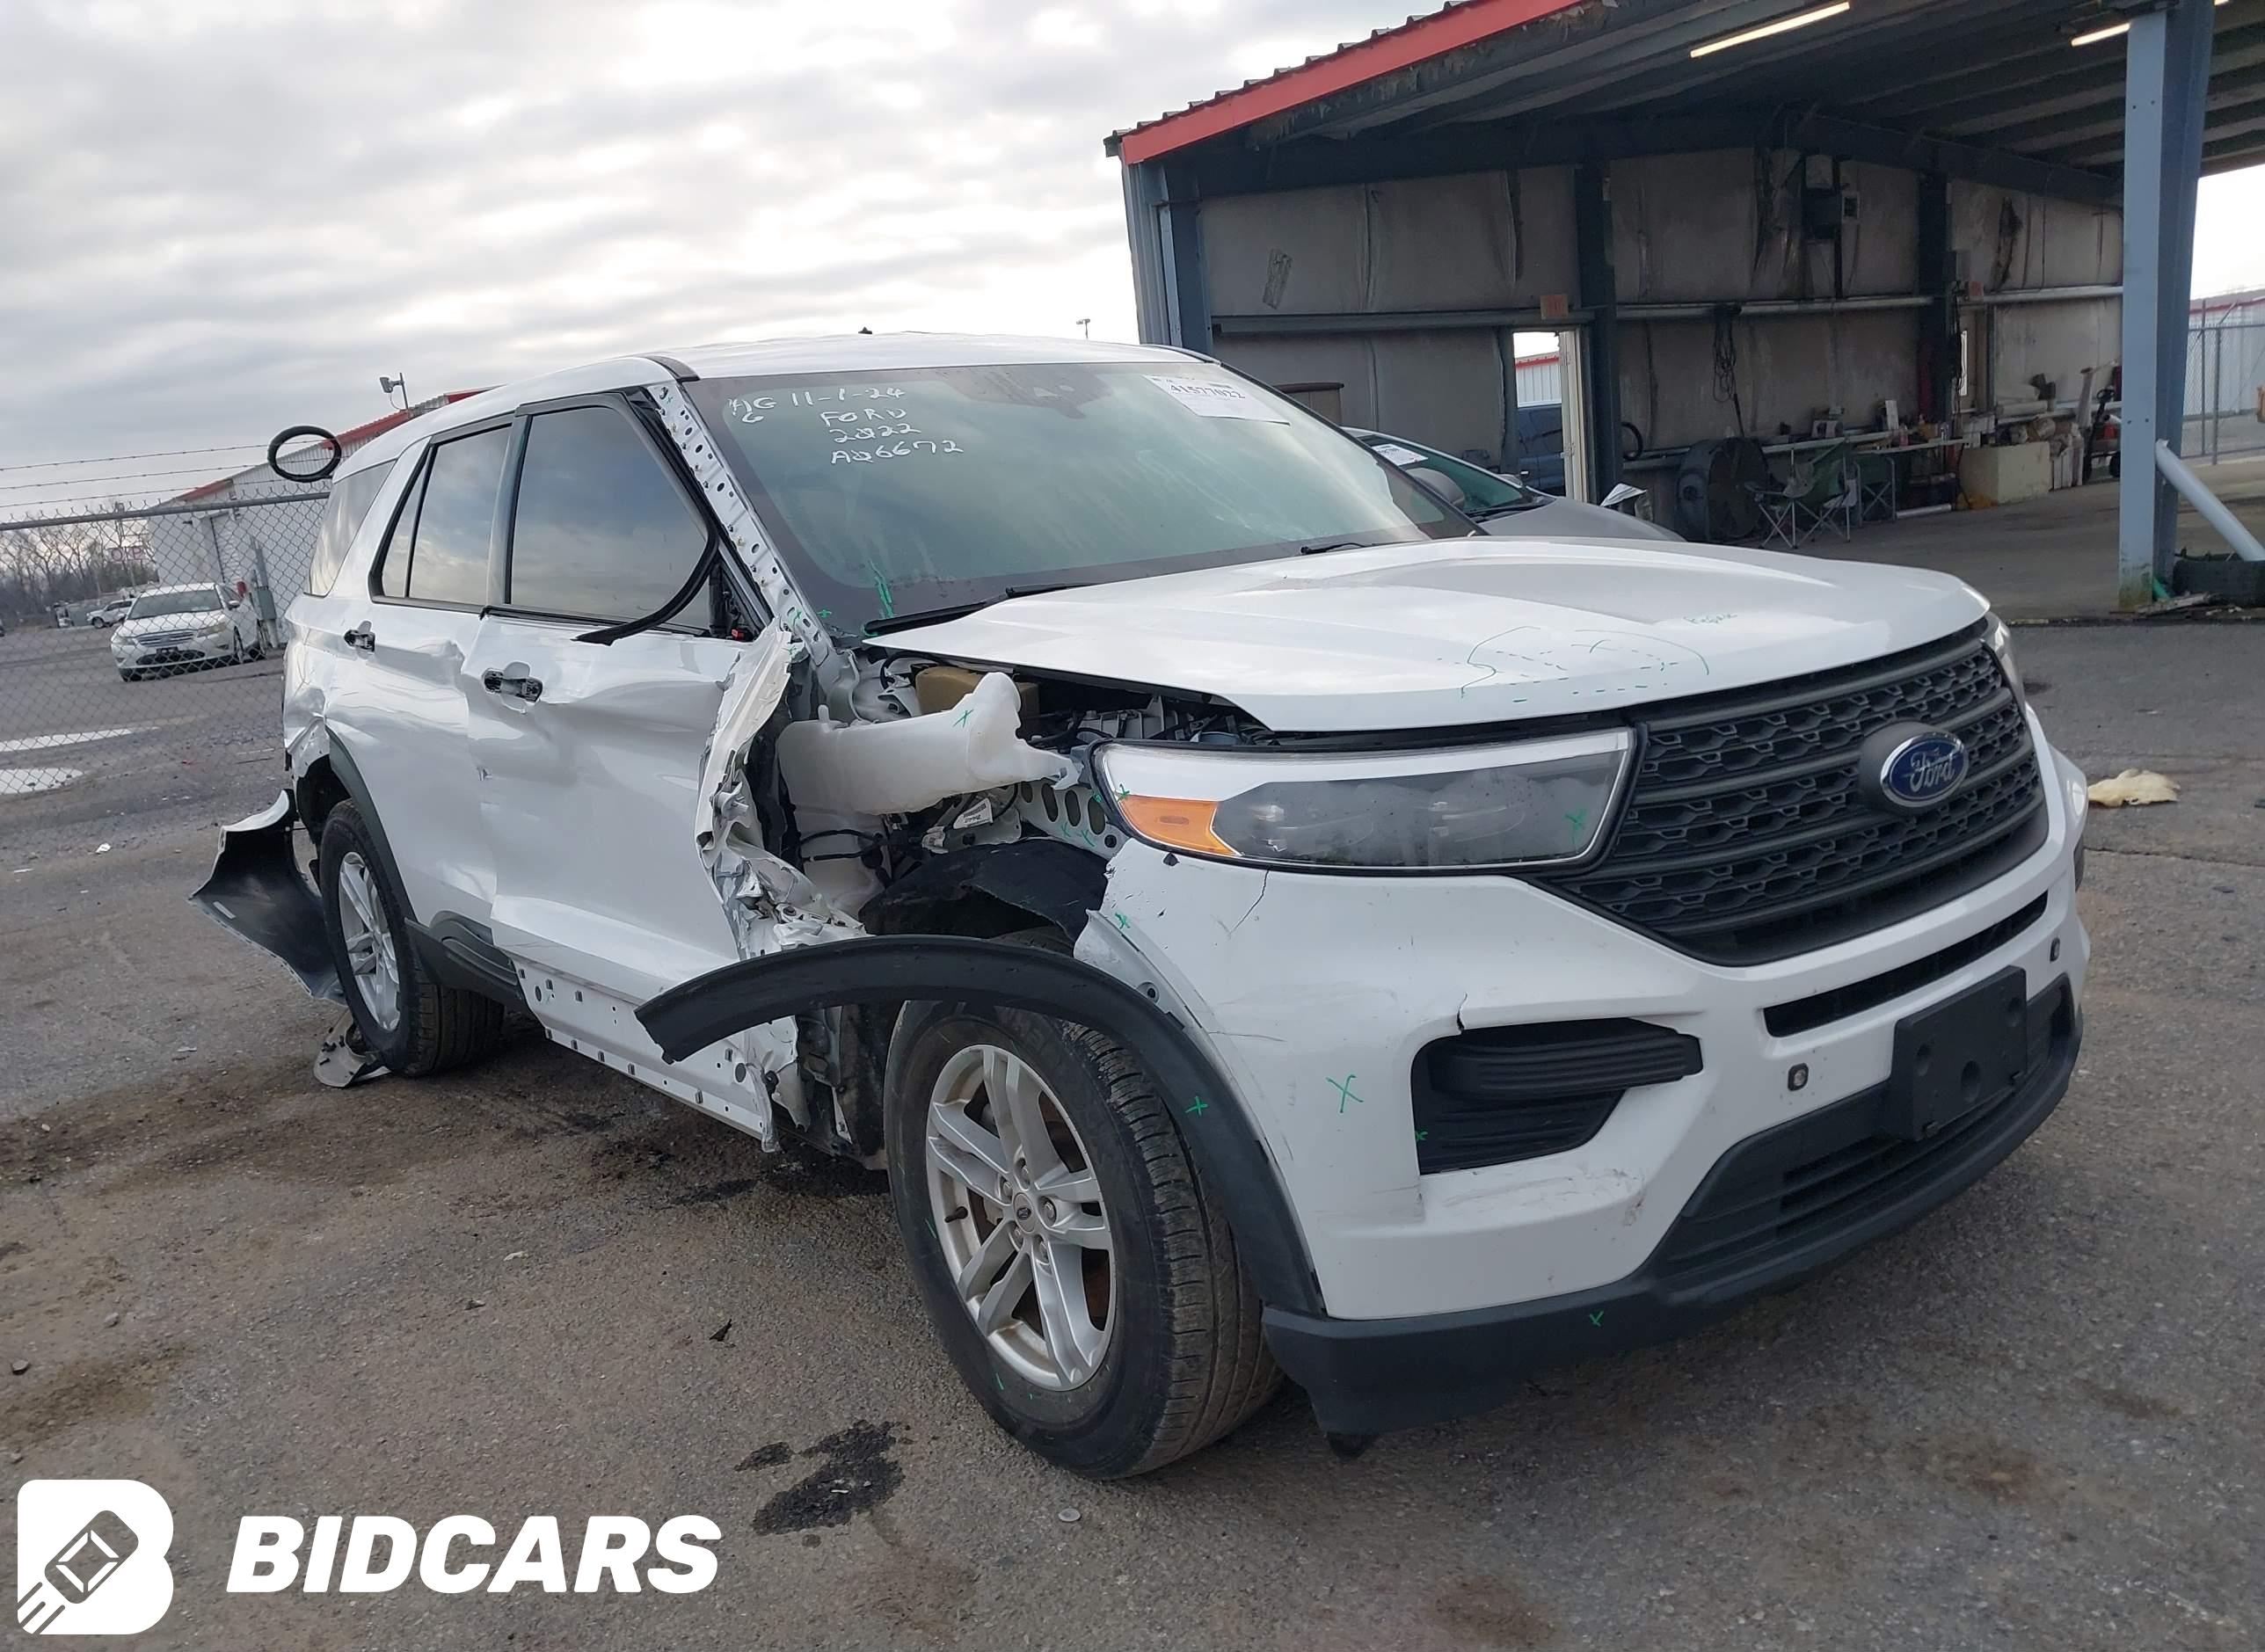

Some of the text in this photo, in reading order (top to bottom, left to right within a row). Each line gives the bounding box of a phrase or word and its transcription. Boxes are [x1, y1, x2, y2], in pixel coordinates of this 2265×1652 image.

[790, 388, 906, 407] 11-1-24
[820, 408, 907, 427] FORD
[829, 422, 921, 443] 2022
[1902, 749, 1957, 793] Ford
